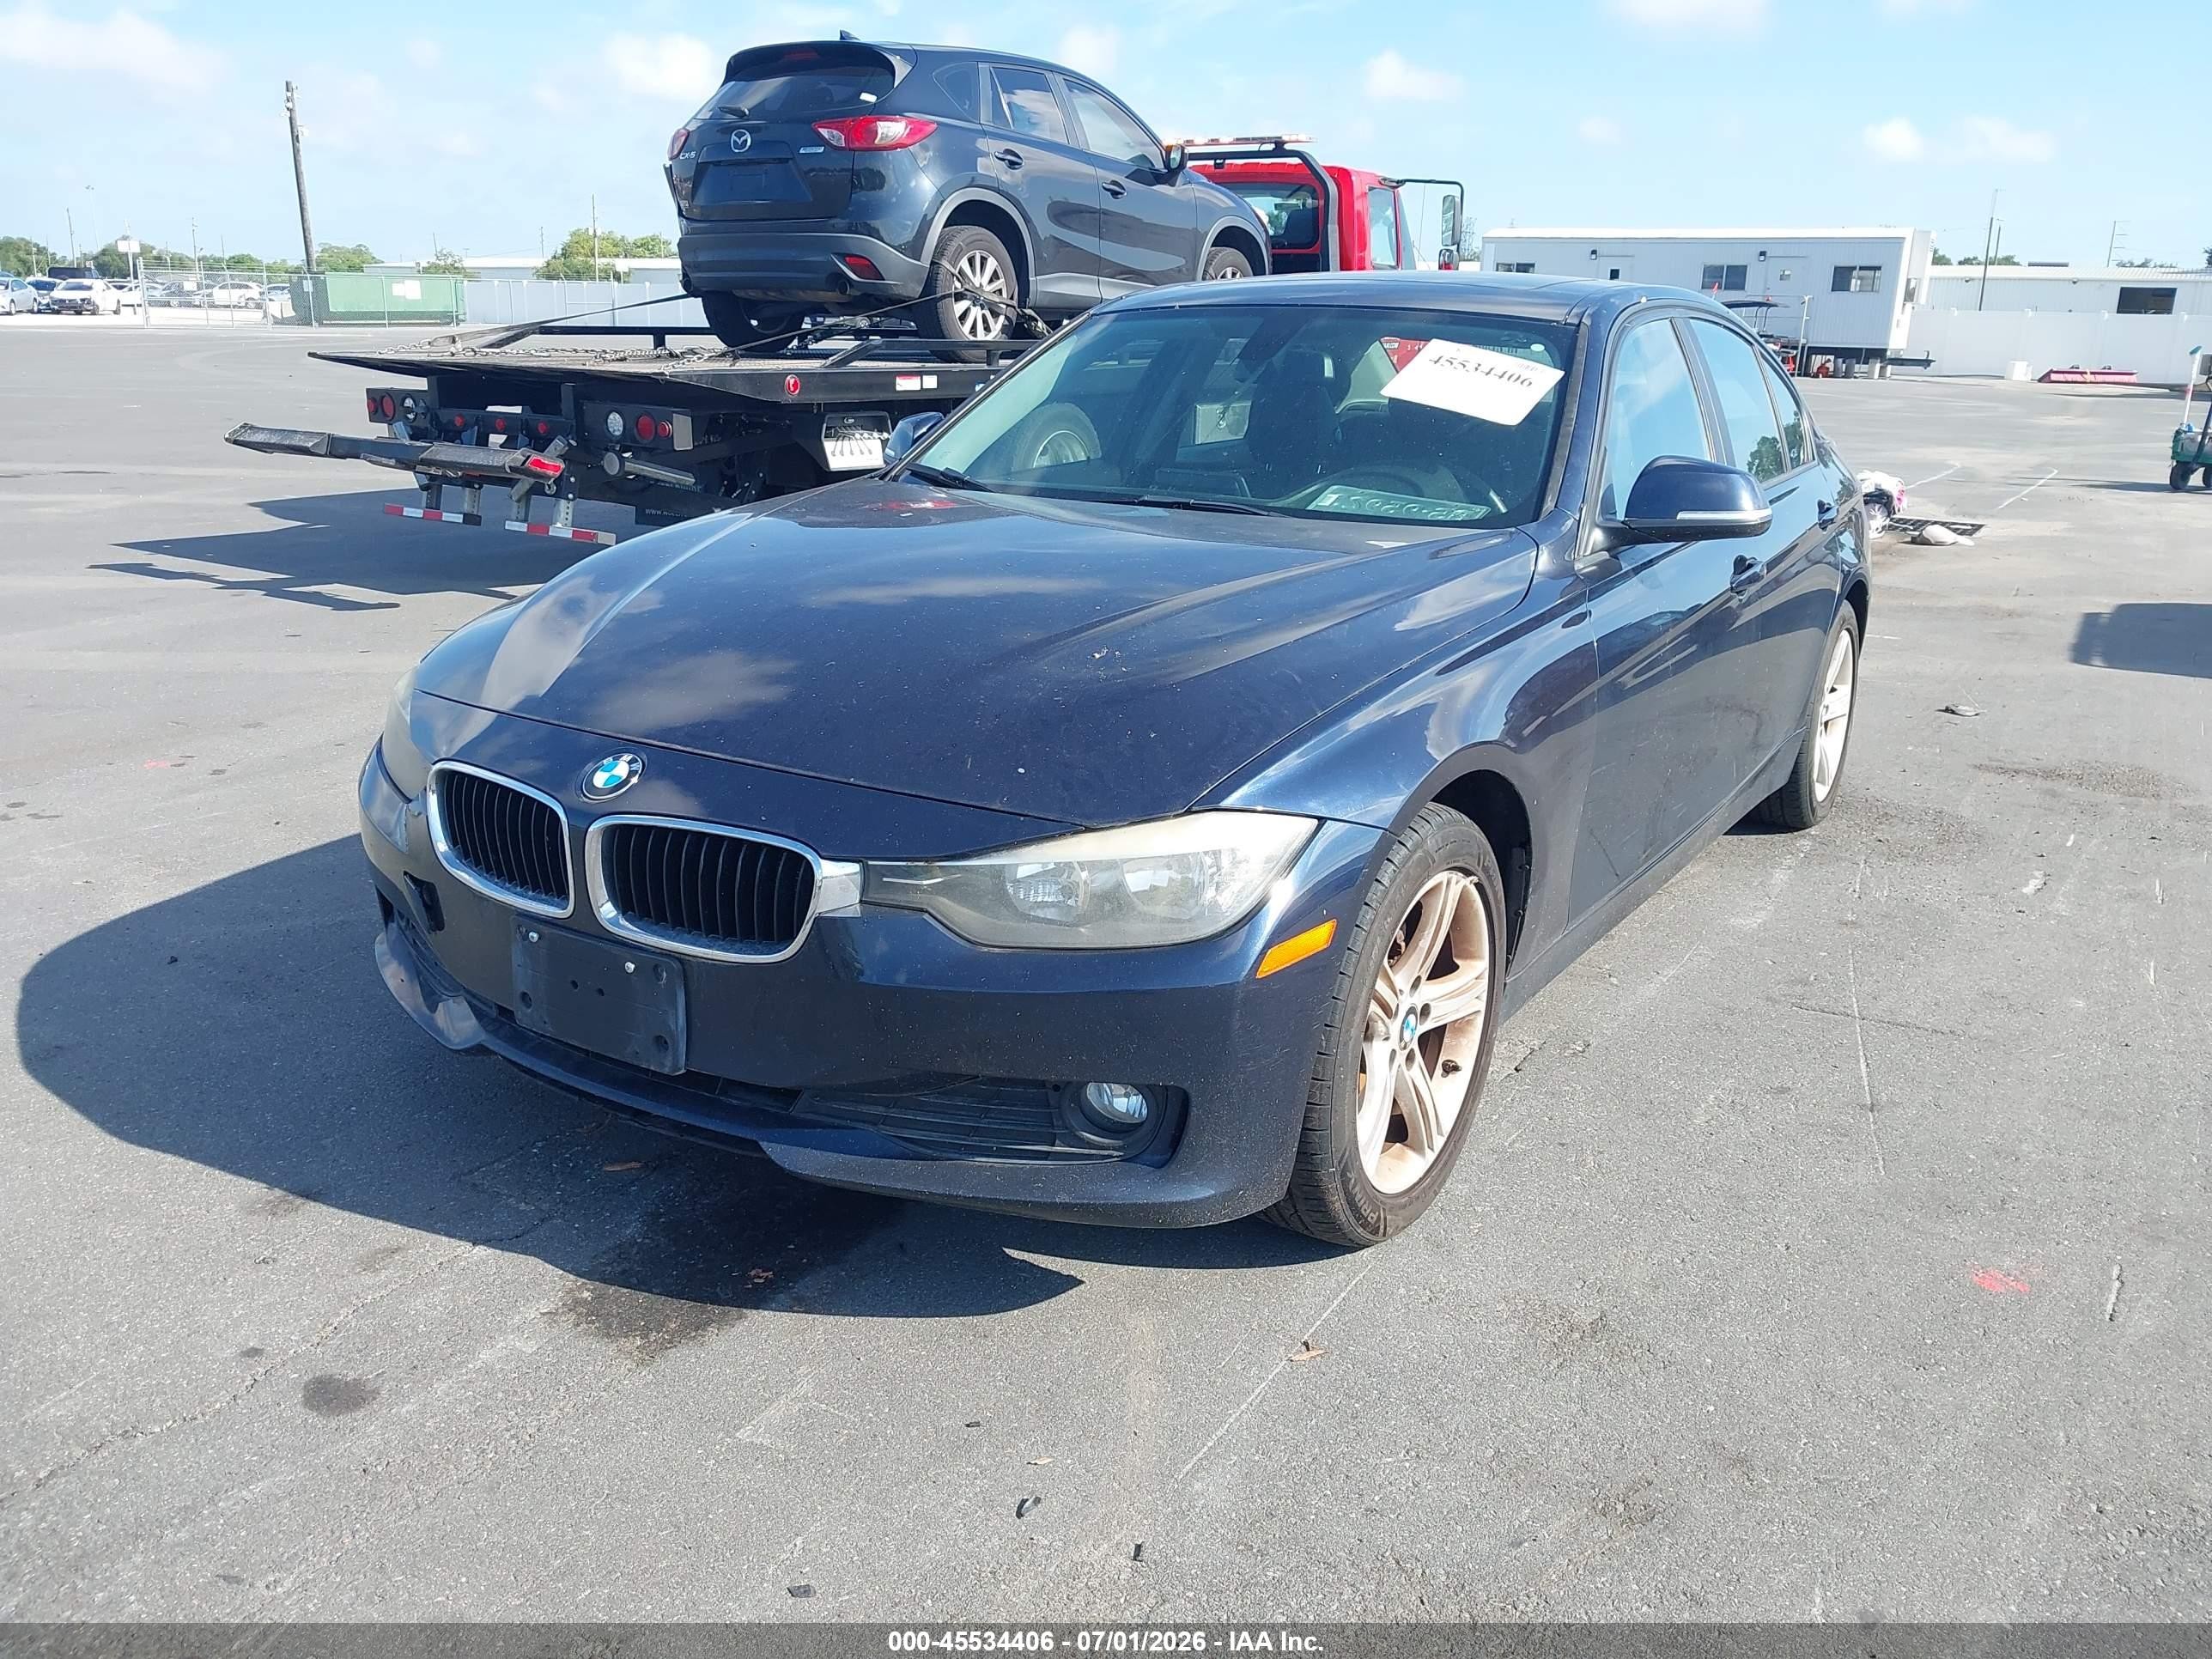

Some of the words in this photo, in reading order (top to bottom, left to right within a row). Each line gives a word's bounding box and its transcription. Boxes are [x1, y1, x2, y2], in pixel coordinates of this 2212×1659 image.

[679, 151, 696, 160] CX-5
[1429, 355, 1533, 387] 45534406
[602, 753, 641, 771] BMW
